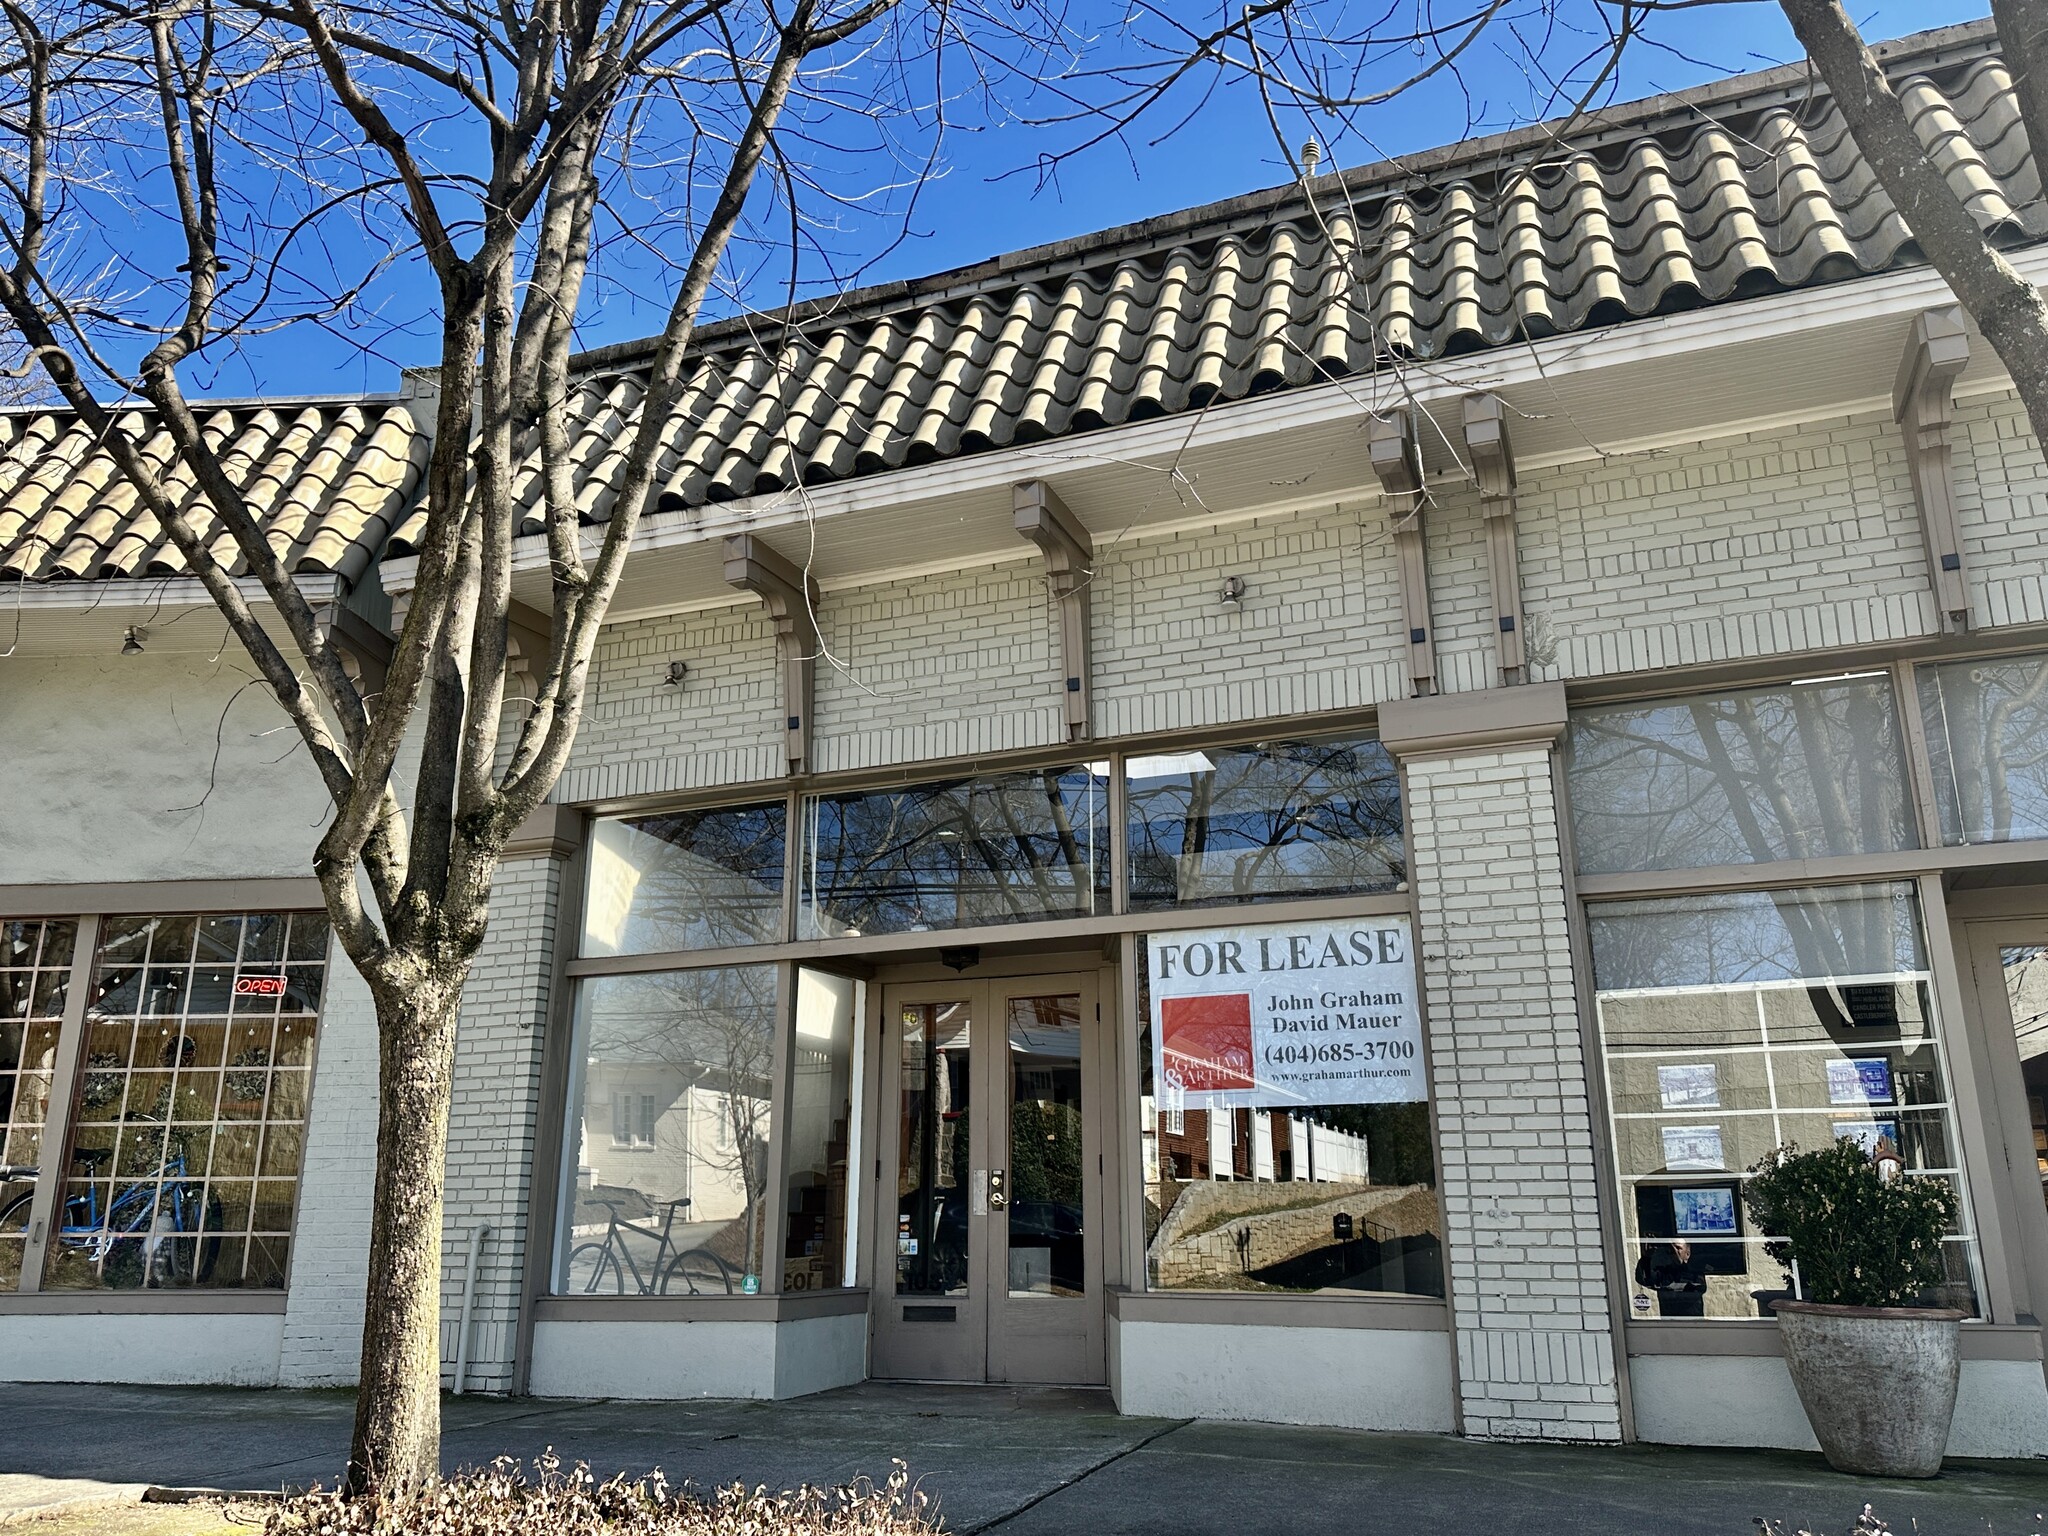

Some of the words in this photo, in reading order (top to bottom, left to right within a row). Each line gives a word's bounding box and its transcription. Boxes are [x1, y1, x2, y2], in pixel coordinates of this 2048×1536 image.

[1158, 940, 1247, 980] FOR
[1257, 928, 1405, 973] LEASE
[237, 979, 285, 994] OPEN
[1267, 994, 1315, 1013] John
[1320, 989, 1404, 1009] Graham
[1272, 1014, 1329, 1034] David
[1336, 1012, 1403, 1031] Mauer
[1174, 1055, 1244, 1073] GRAHAM
[1265, 1040, 1415, 1067] (404)685-3700
[1165, 1068, 1189, 1091] &
[1184, 1068, 1252, 1085] ARTHUR
[1271, 1067, 1412, 1084] www.grahamarthur.com
